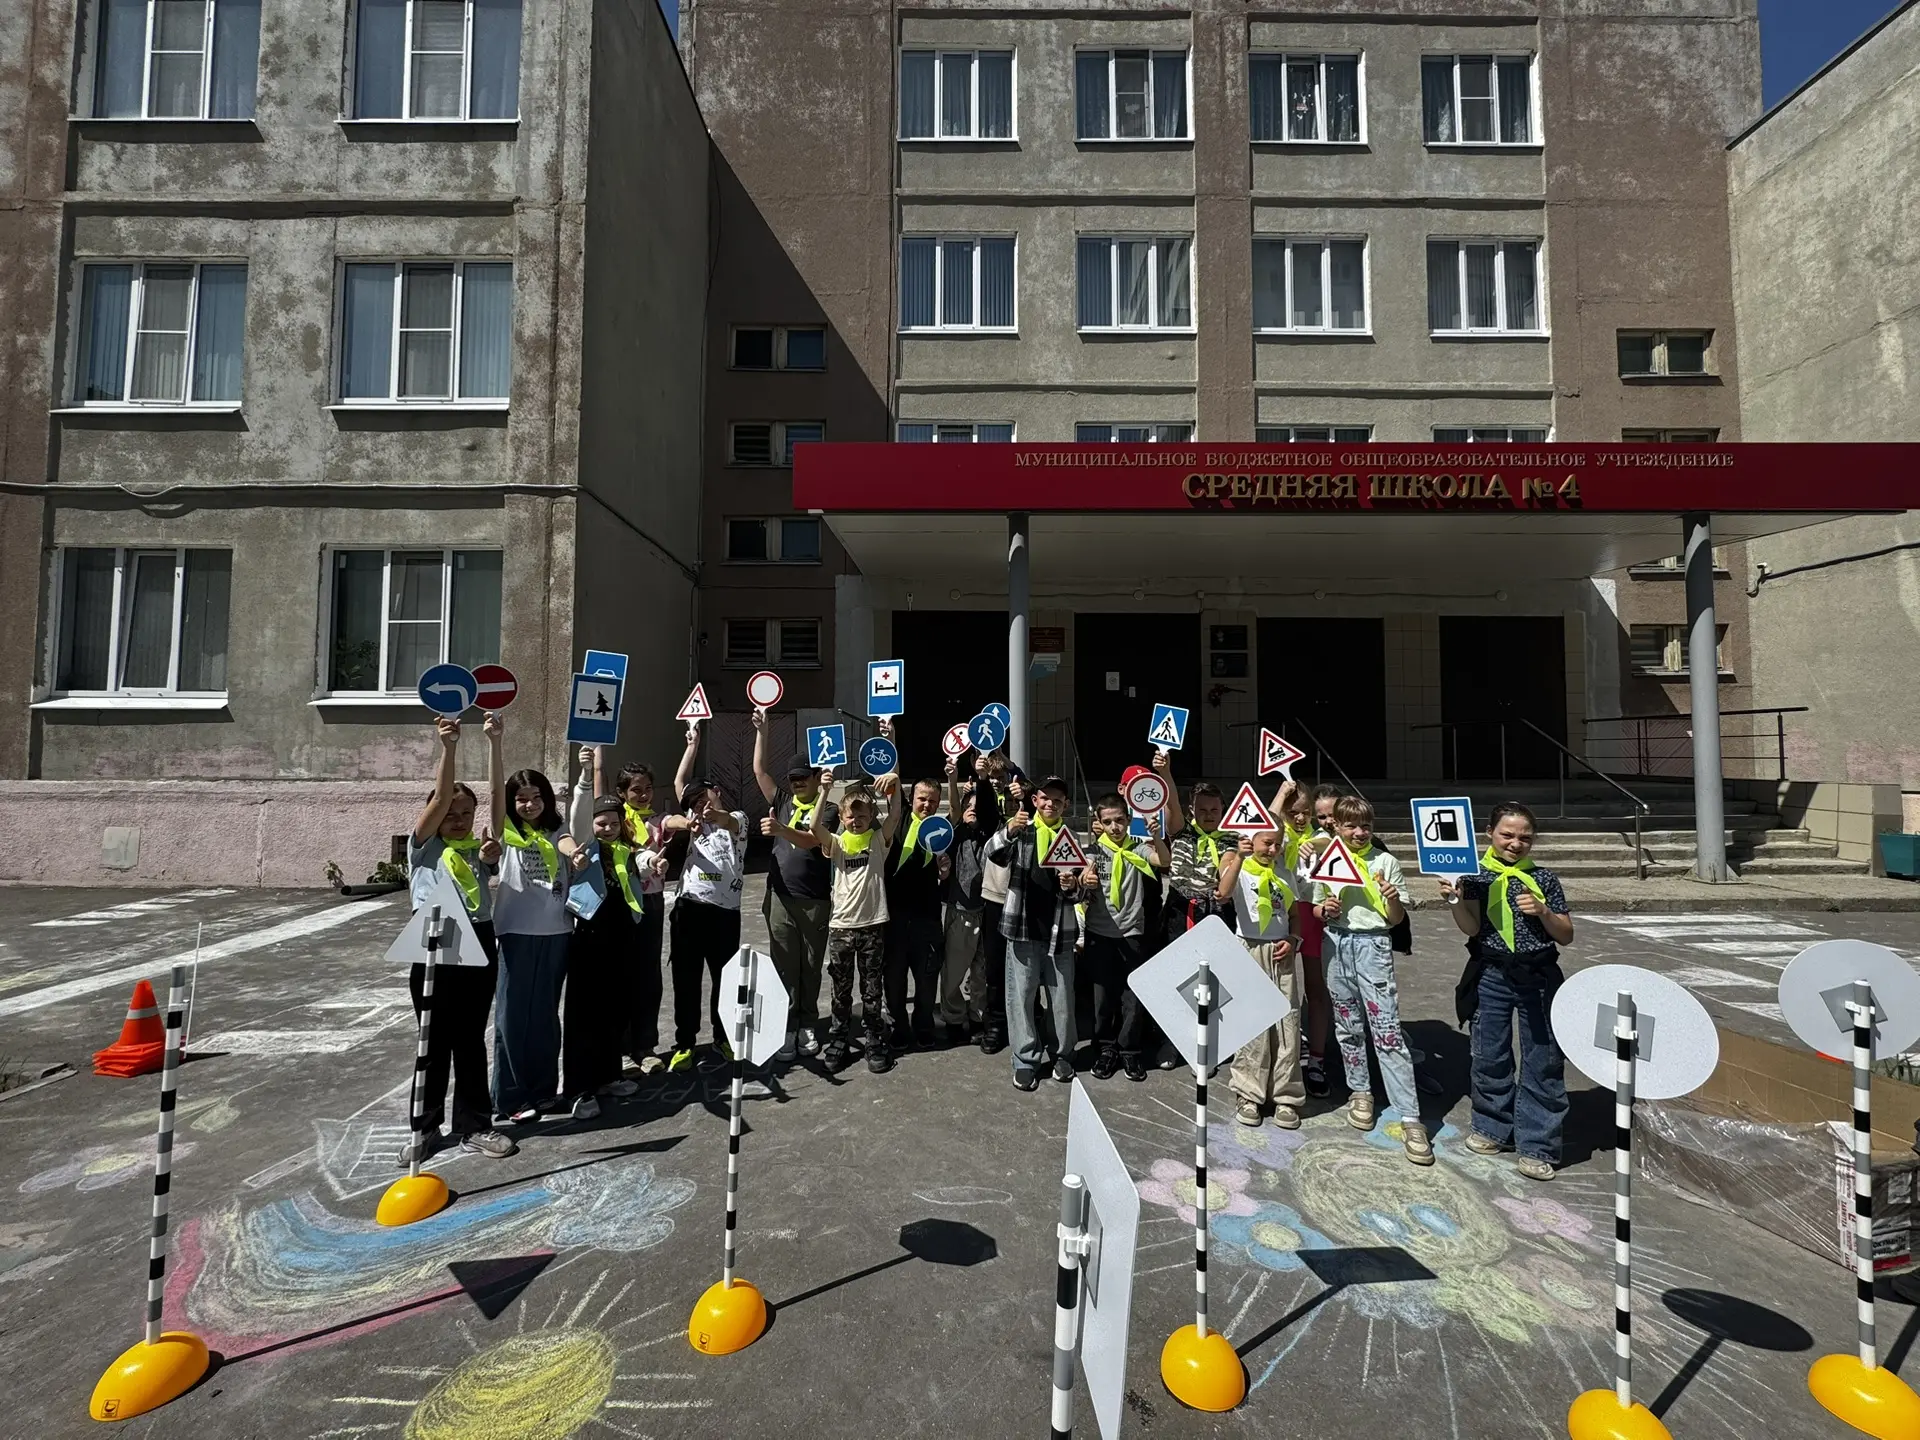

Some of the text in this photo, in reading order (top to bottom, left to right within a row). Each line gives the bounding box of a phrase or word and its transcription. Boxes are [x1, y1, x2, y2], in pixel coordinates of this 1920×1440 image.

[1015, 453, 1734, 469] МУНИЦИПАЛЬНОЕ БЮДЖЕТНОЕ ОБЩЕОБРАЗОВАТЕЛЬНОЕ УЧРЕЖДЕНИЕ
[1182, 473, 1357, 504] СРЕДНЯЯ
[1367, 473, 1512, 499] ШКОЛА
[1429, 853, 1453, 864] 800
